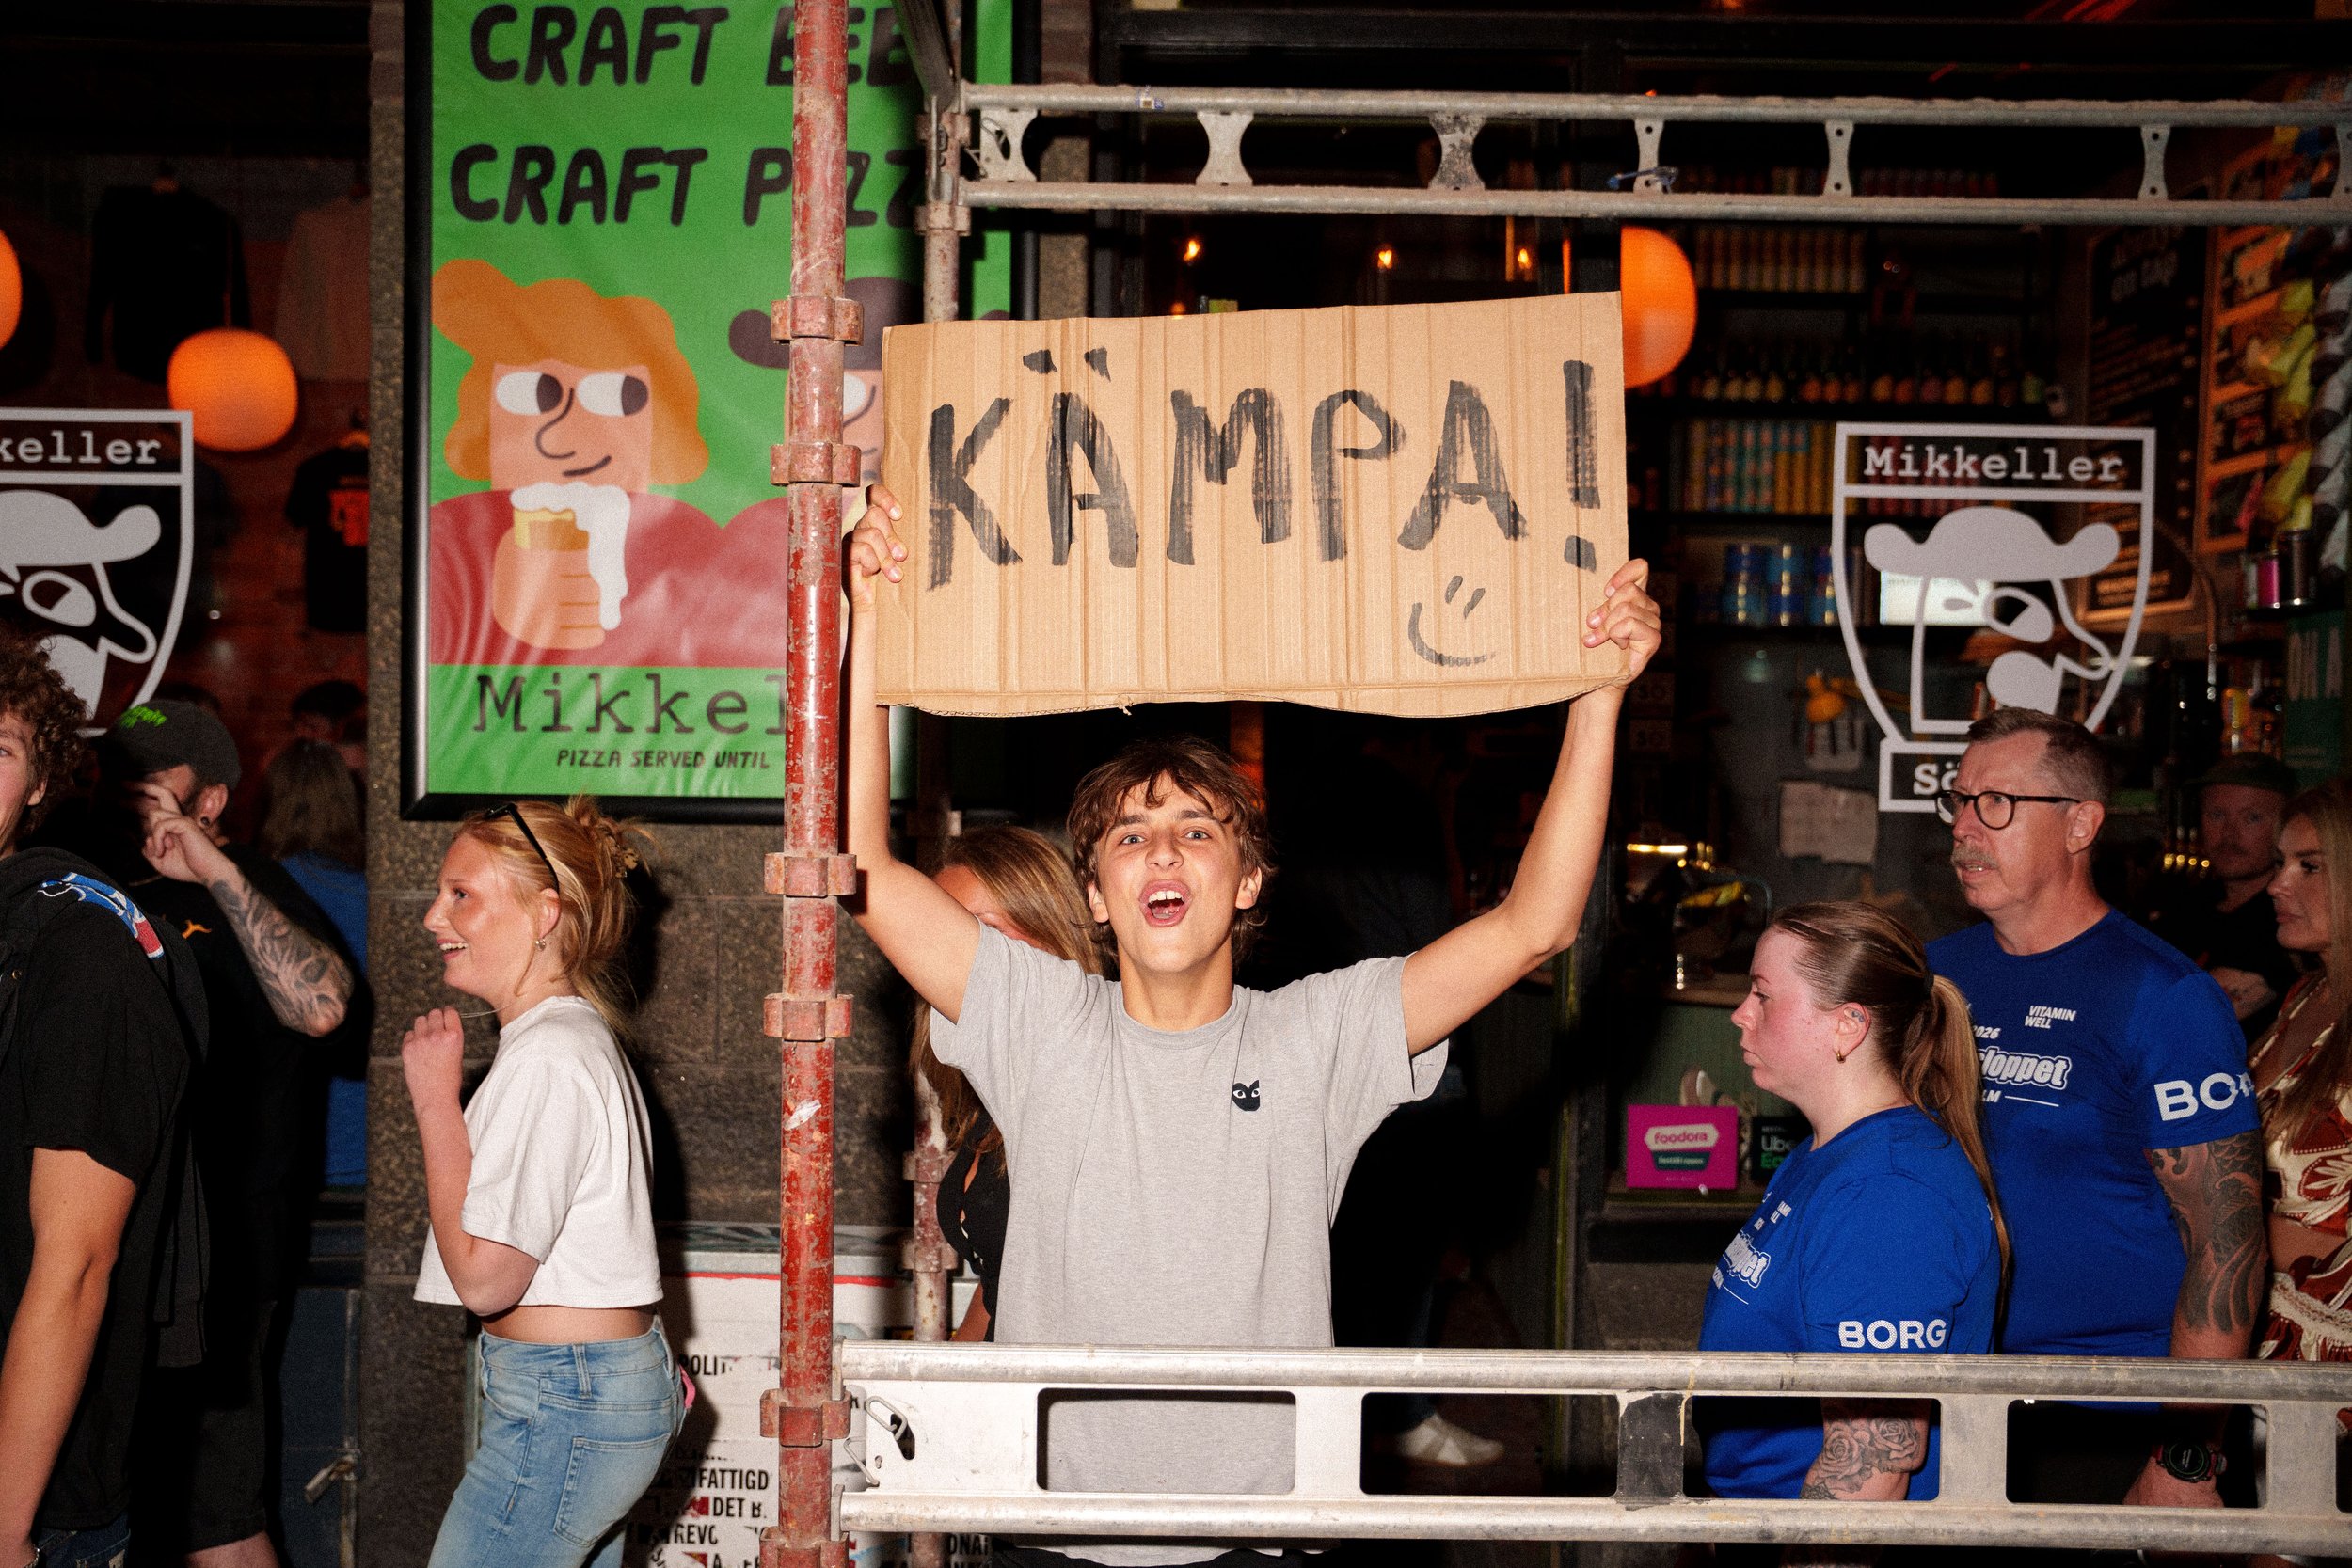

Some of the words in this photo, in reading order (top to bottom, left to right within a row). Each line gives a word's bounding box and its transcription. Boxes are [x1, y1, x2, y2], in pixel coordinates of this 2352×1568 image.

[471, 4, 729, 87] CRAFT
[450, 143, 708, 226] CRAFT
[927, 346, 1601, 591] KÄMPA!
[1863, 443, 2124, 482] Mikkeller
[557, 749, 622, 768] PIZZA
[629, 750, 706, 768] SERVED
[714, 751, 770, 769] UNTIL
[2024, 1015, 2052, 1029] WELL
[2028, 1005, 2077, 1022] VITAMIN
[1654, 1131, 1708, 1145] foodora
[1838, 1319, 1947, 1350] BORG
[713, 1497, 745, 1518] DET
